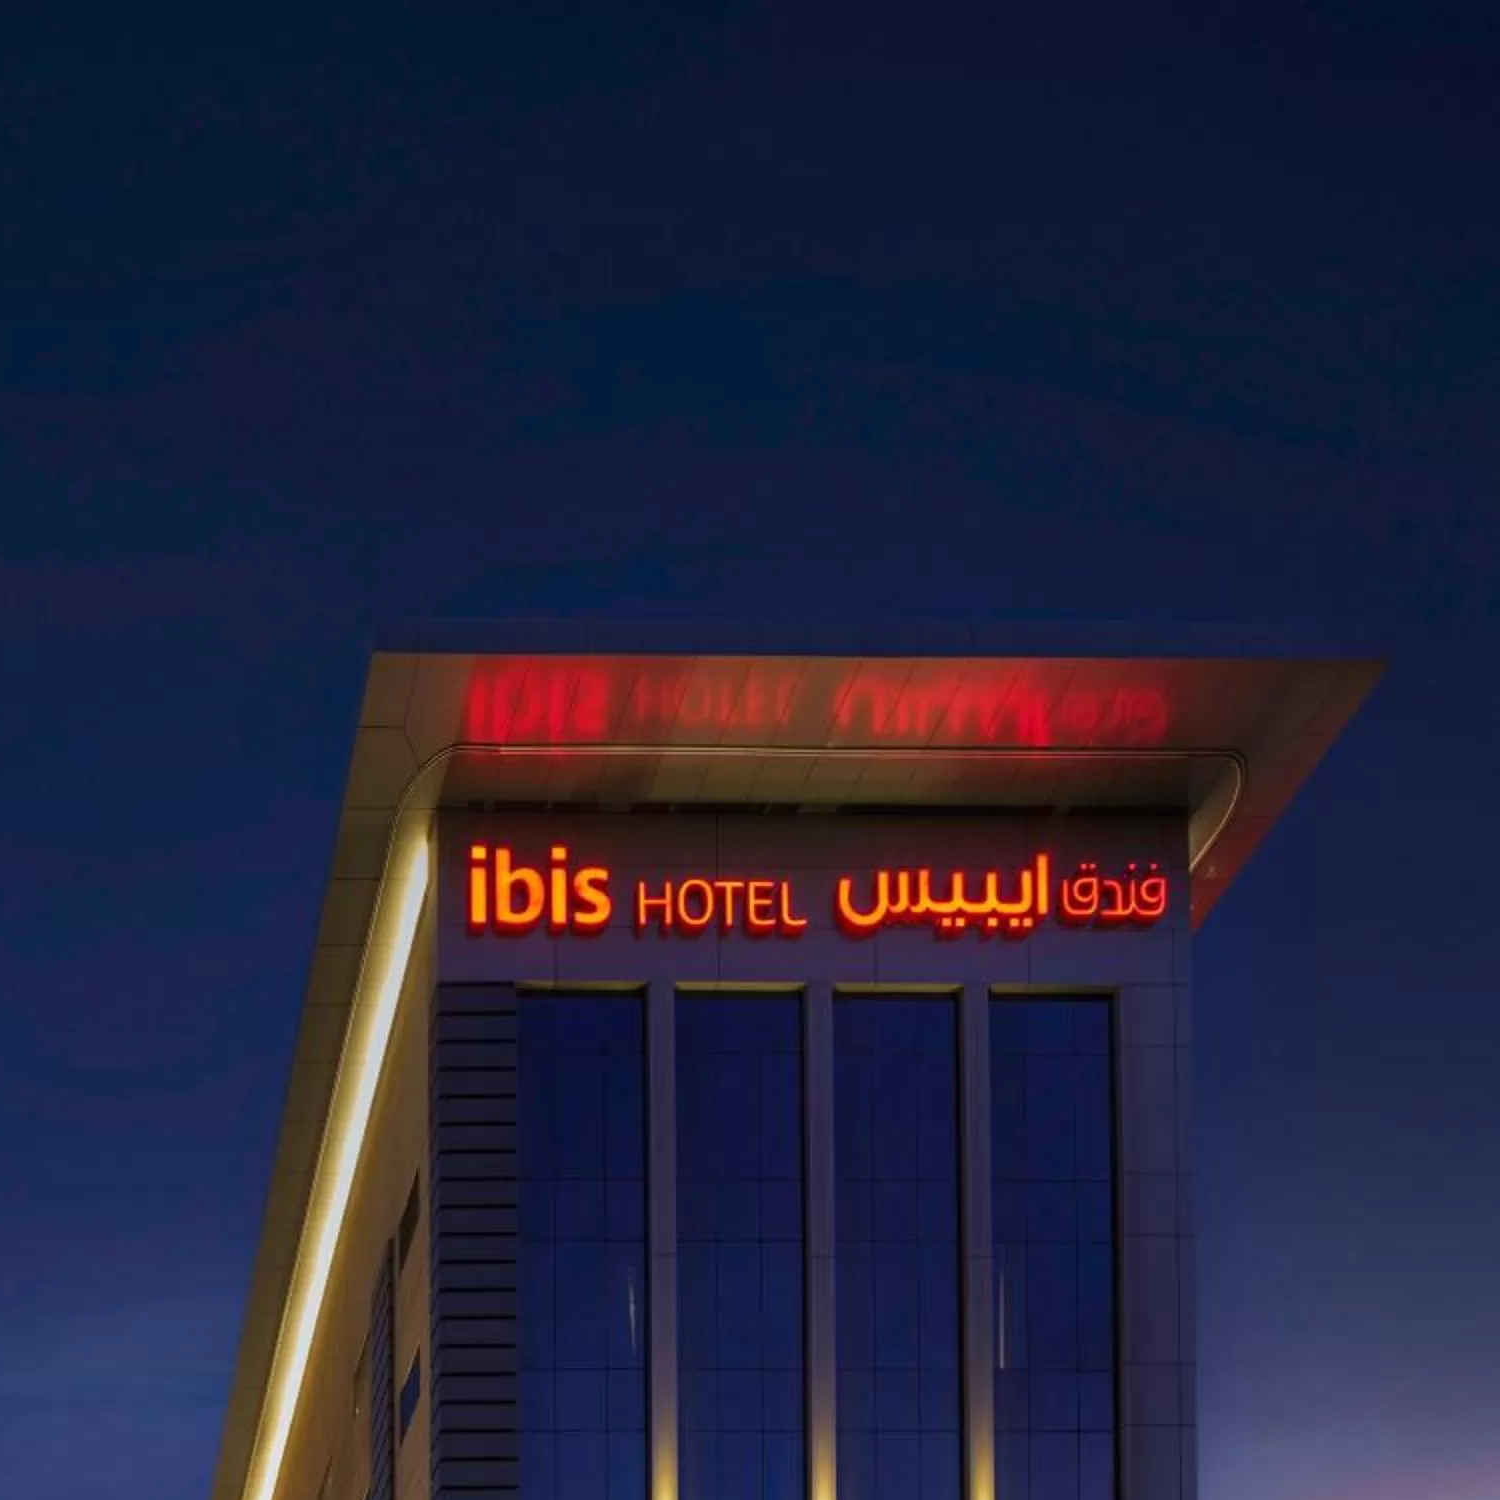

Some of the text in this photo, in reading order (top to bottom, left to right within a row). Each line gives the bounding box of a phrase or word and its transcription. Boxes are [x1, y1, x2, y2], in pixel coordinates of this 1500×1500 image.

[470, 846, 807, 926] ibis HOTEL
[838, 853, 1166, 927] فندق ايبيس
